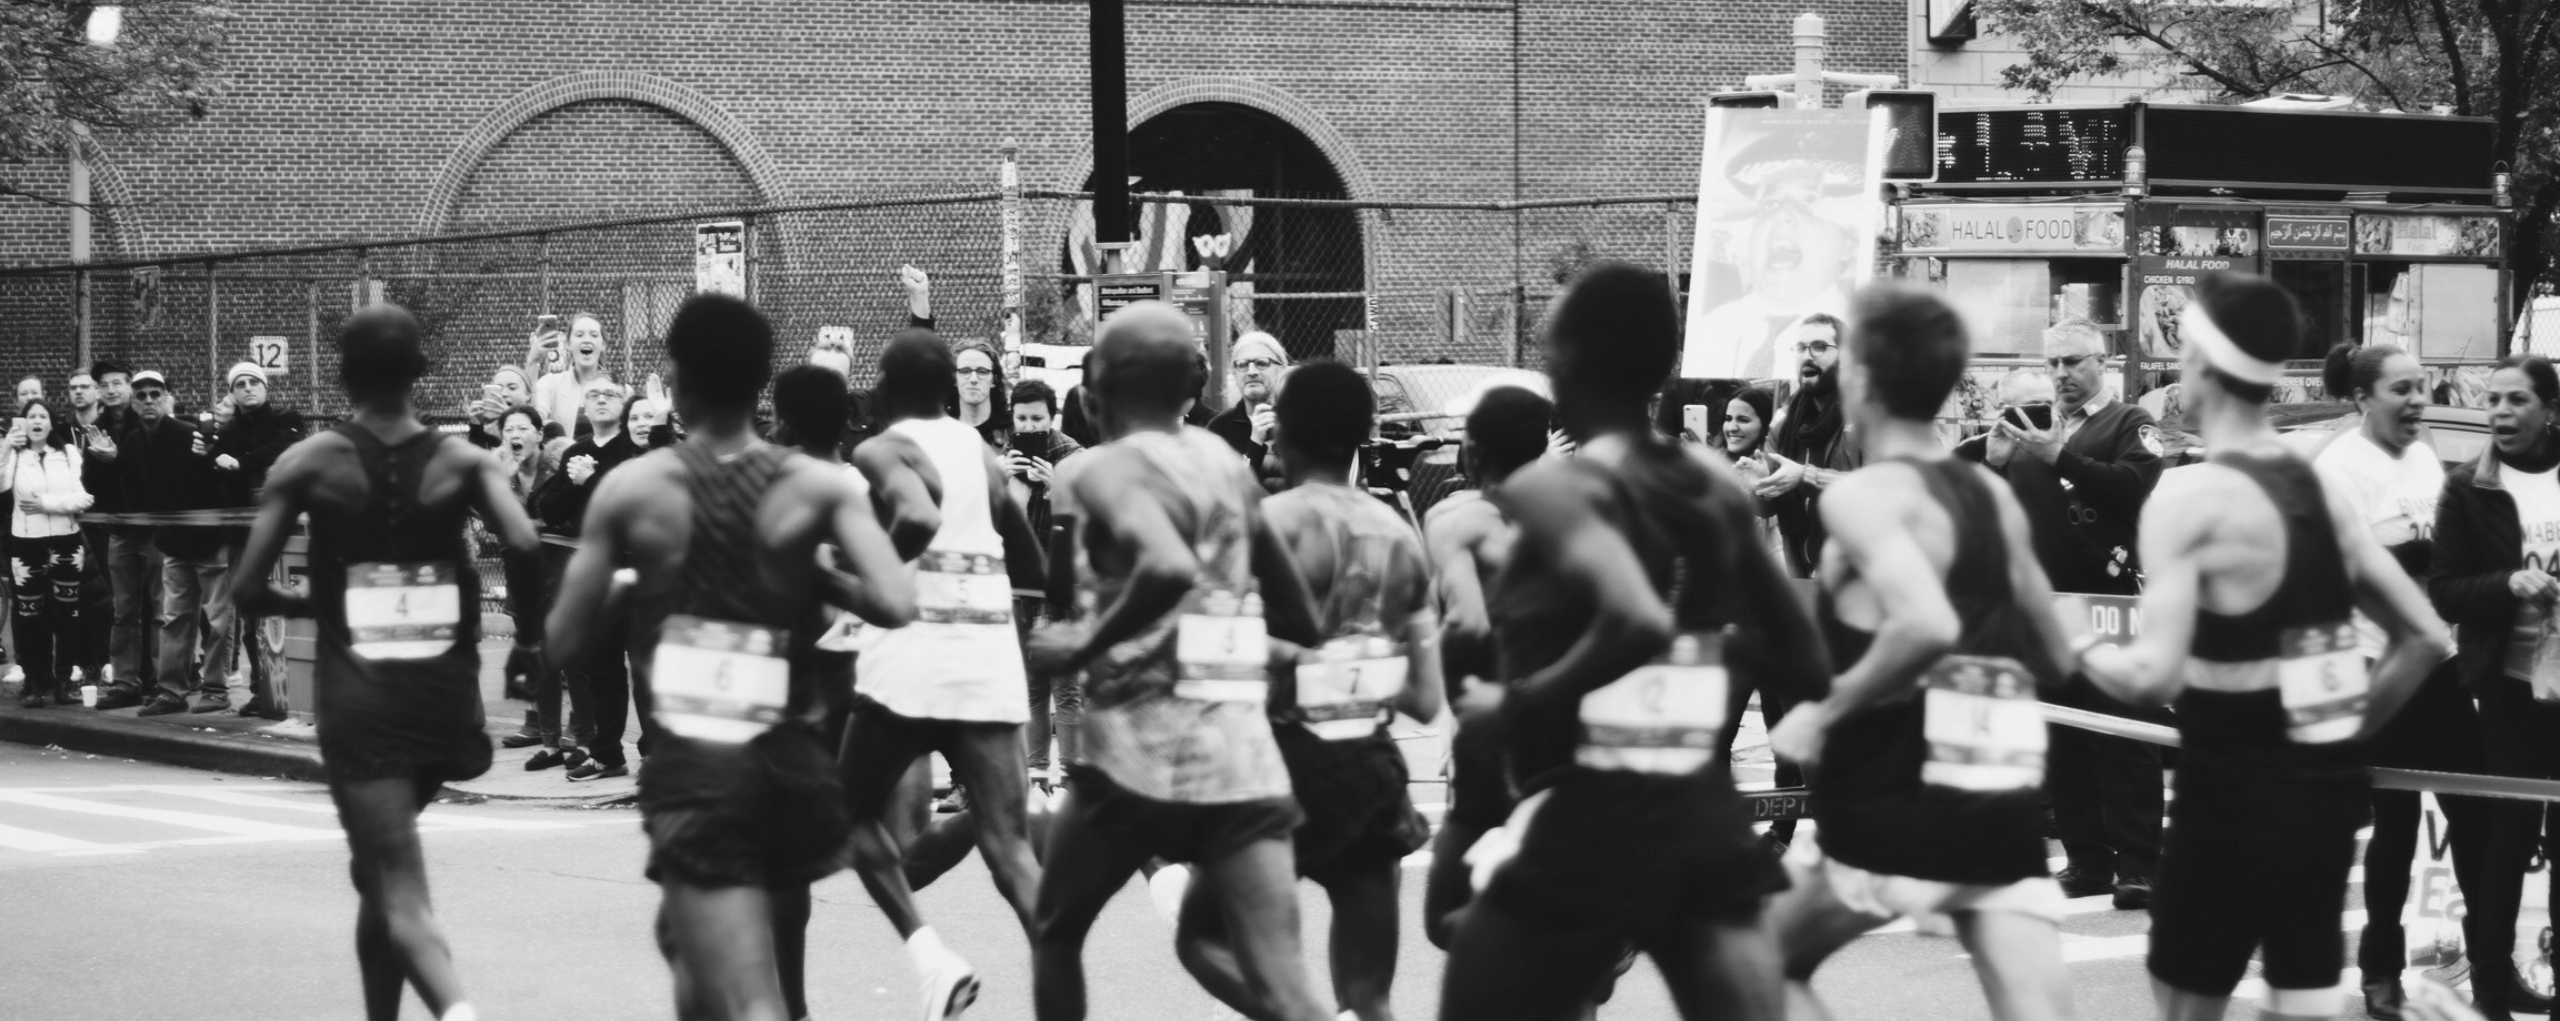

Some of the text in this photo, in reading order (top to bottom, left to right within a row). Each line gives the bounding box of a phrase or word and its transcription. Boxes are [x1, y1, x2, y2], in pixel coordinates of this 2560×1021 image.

[1952, 218, 2072, 240] HALAL FOOD
[2165, 259, 2230, 270] HALAL FOOD
[2143, 275, 2196, 285] CHICKEN GYRO
[256, 343, 281, 368] 12
[2140, 361, 2165, 371] FALAFEL
[395, 592, 409, 618] 4
[2091, 605, 2120, 635] DO
[715, 658, 735, 691] 6
[1349, 667, 1362, 695] 7
